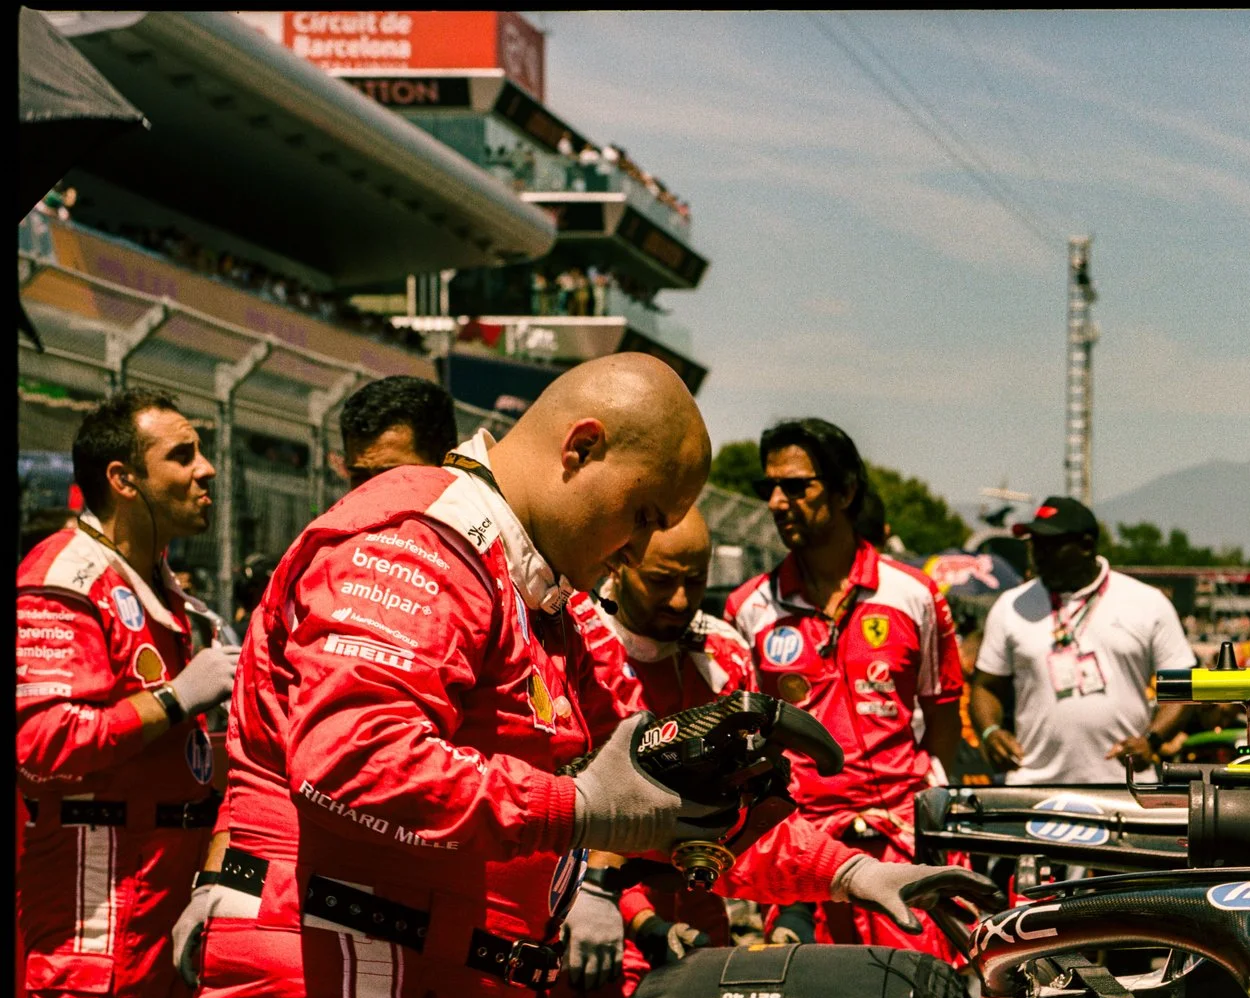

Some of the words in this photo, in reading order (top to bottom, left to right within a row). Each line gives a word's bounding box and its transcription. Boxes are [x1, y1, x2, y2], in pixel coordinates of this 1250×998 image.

[293, 12, 377, 34] Circuit
[379, 12, 413, 34] de
[293, 35, 412, 59] Barcelona
[352, 547, 440, 595] brembo
[341, 581, 422, 616] ambipar
[18, 627, 75, 641] brembo
[323, 633, 416, 672] PIRELLI
[299, 779, 390, 835] RICHARD
